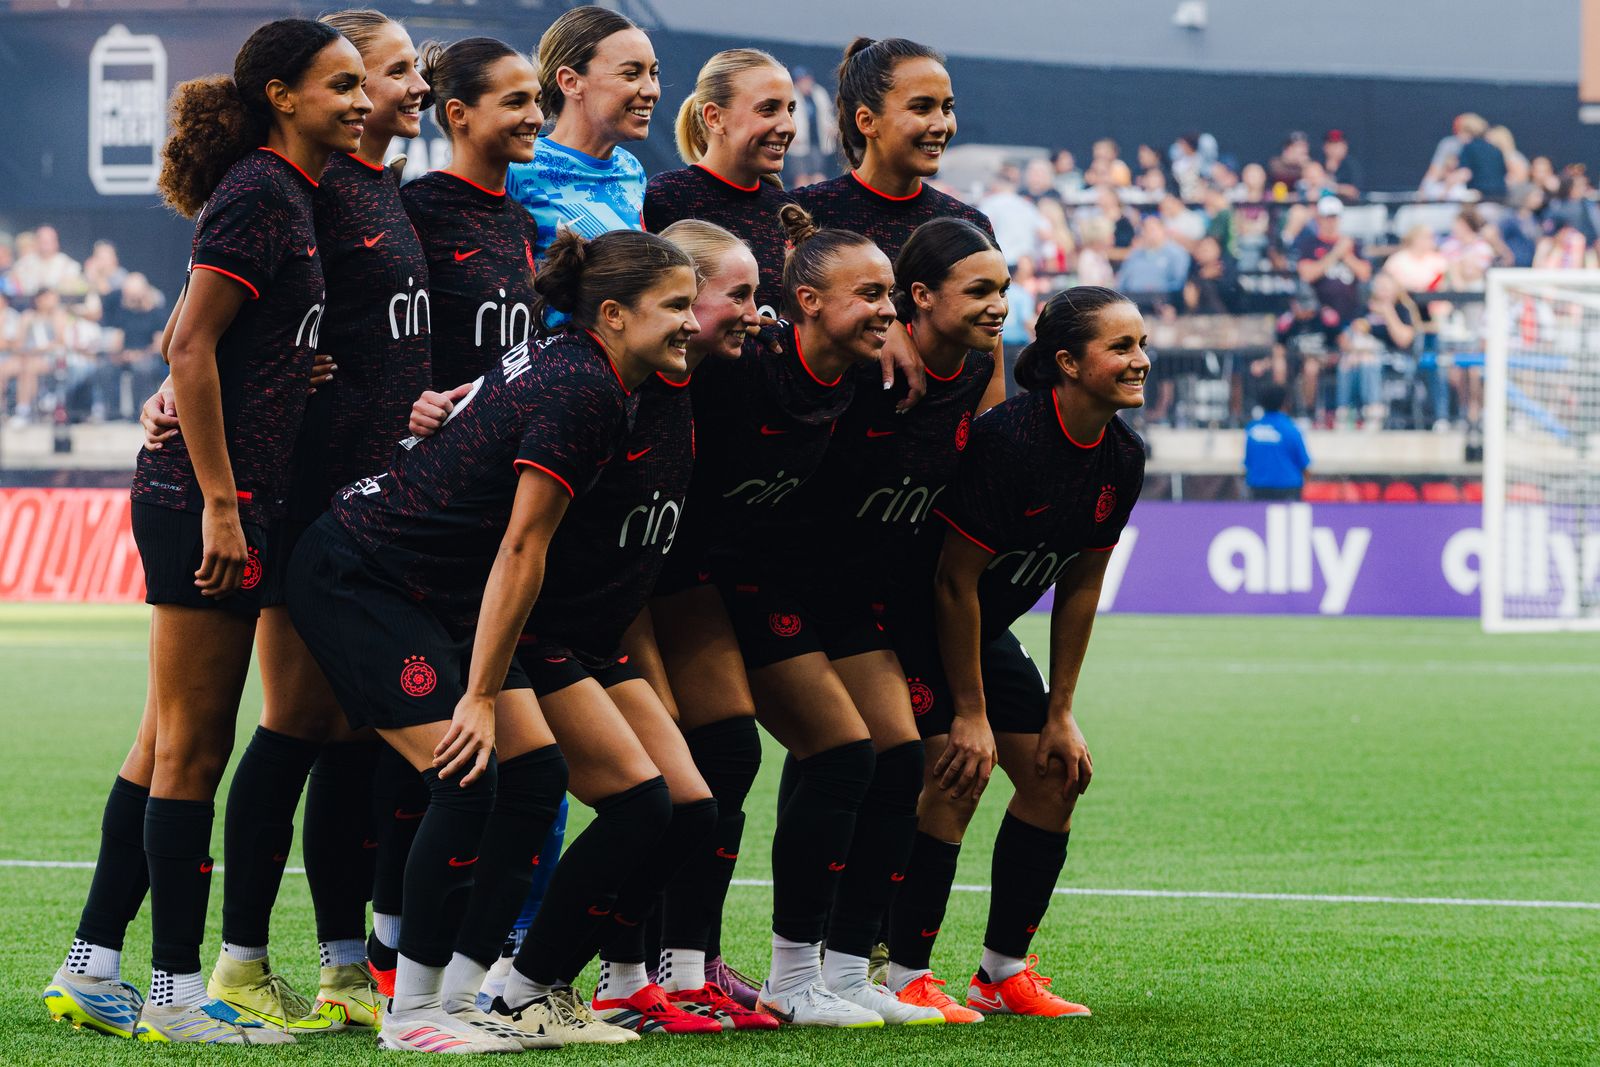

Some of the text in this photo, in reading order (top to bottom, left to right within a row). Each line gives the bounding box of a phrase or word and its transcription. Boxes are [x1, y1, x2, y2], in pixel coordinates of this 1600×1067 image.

[389, 276, 432, 340] rin
[475, 288, 531, 347] rin
[722, 470, 802, 507] rin
[1207, 503, 1373, 614] ally
